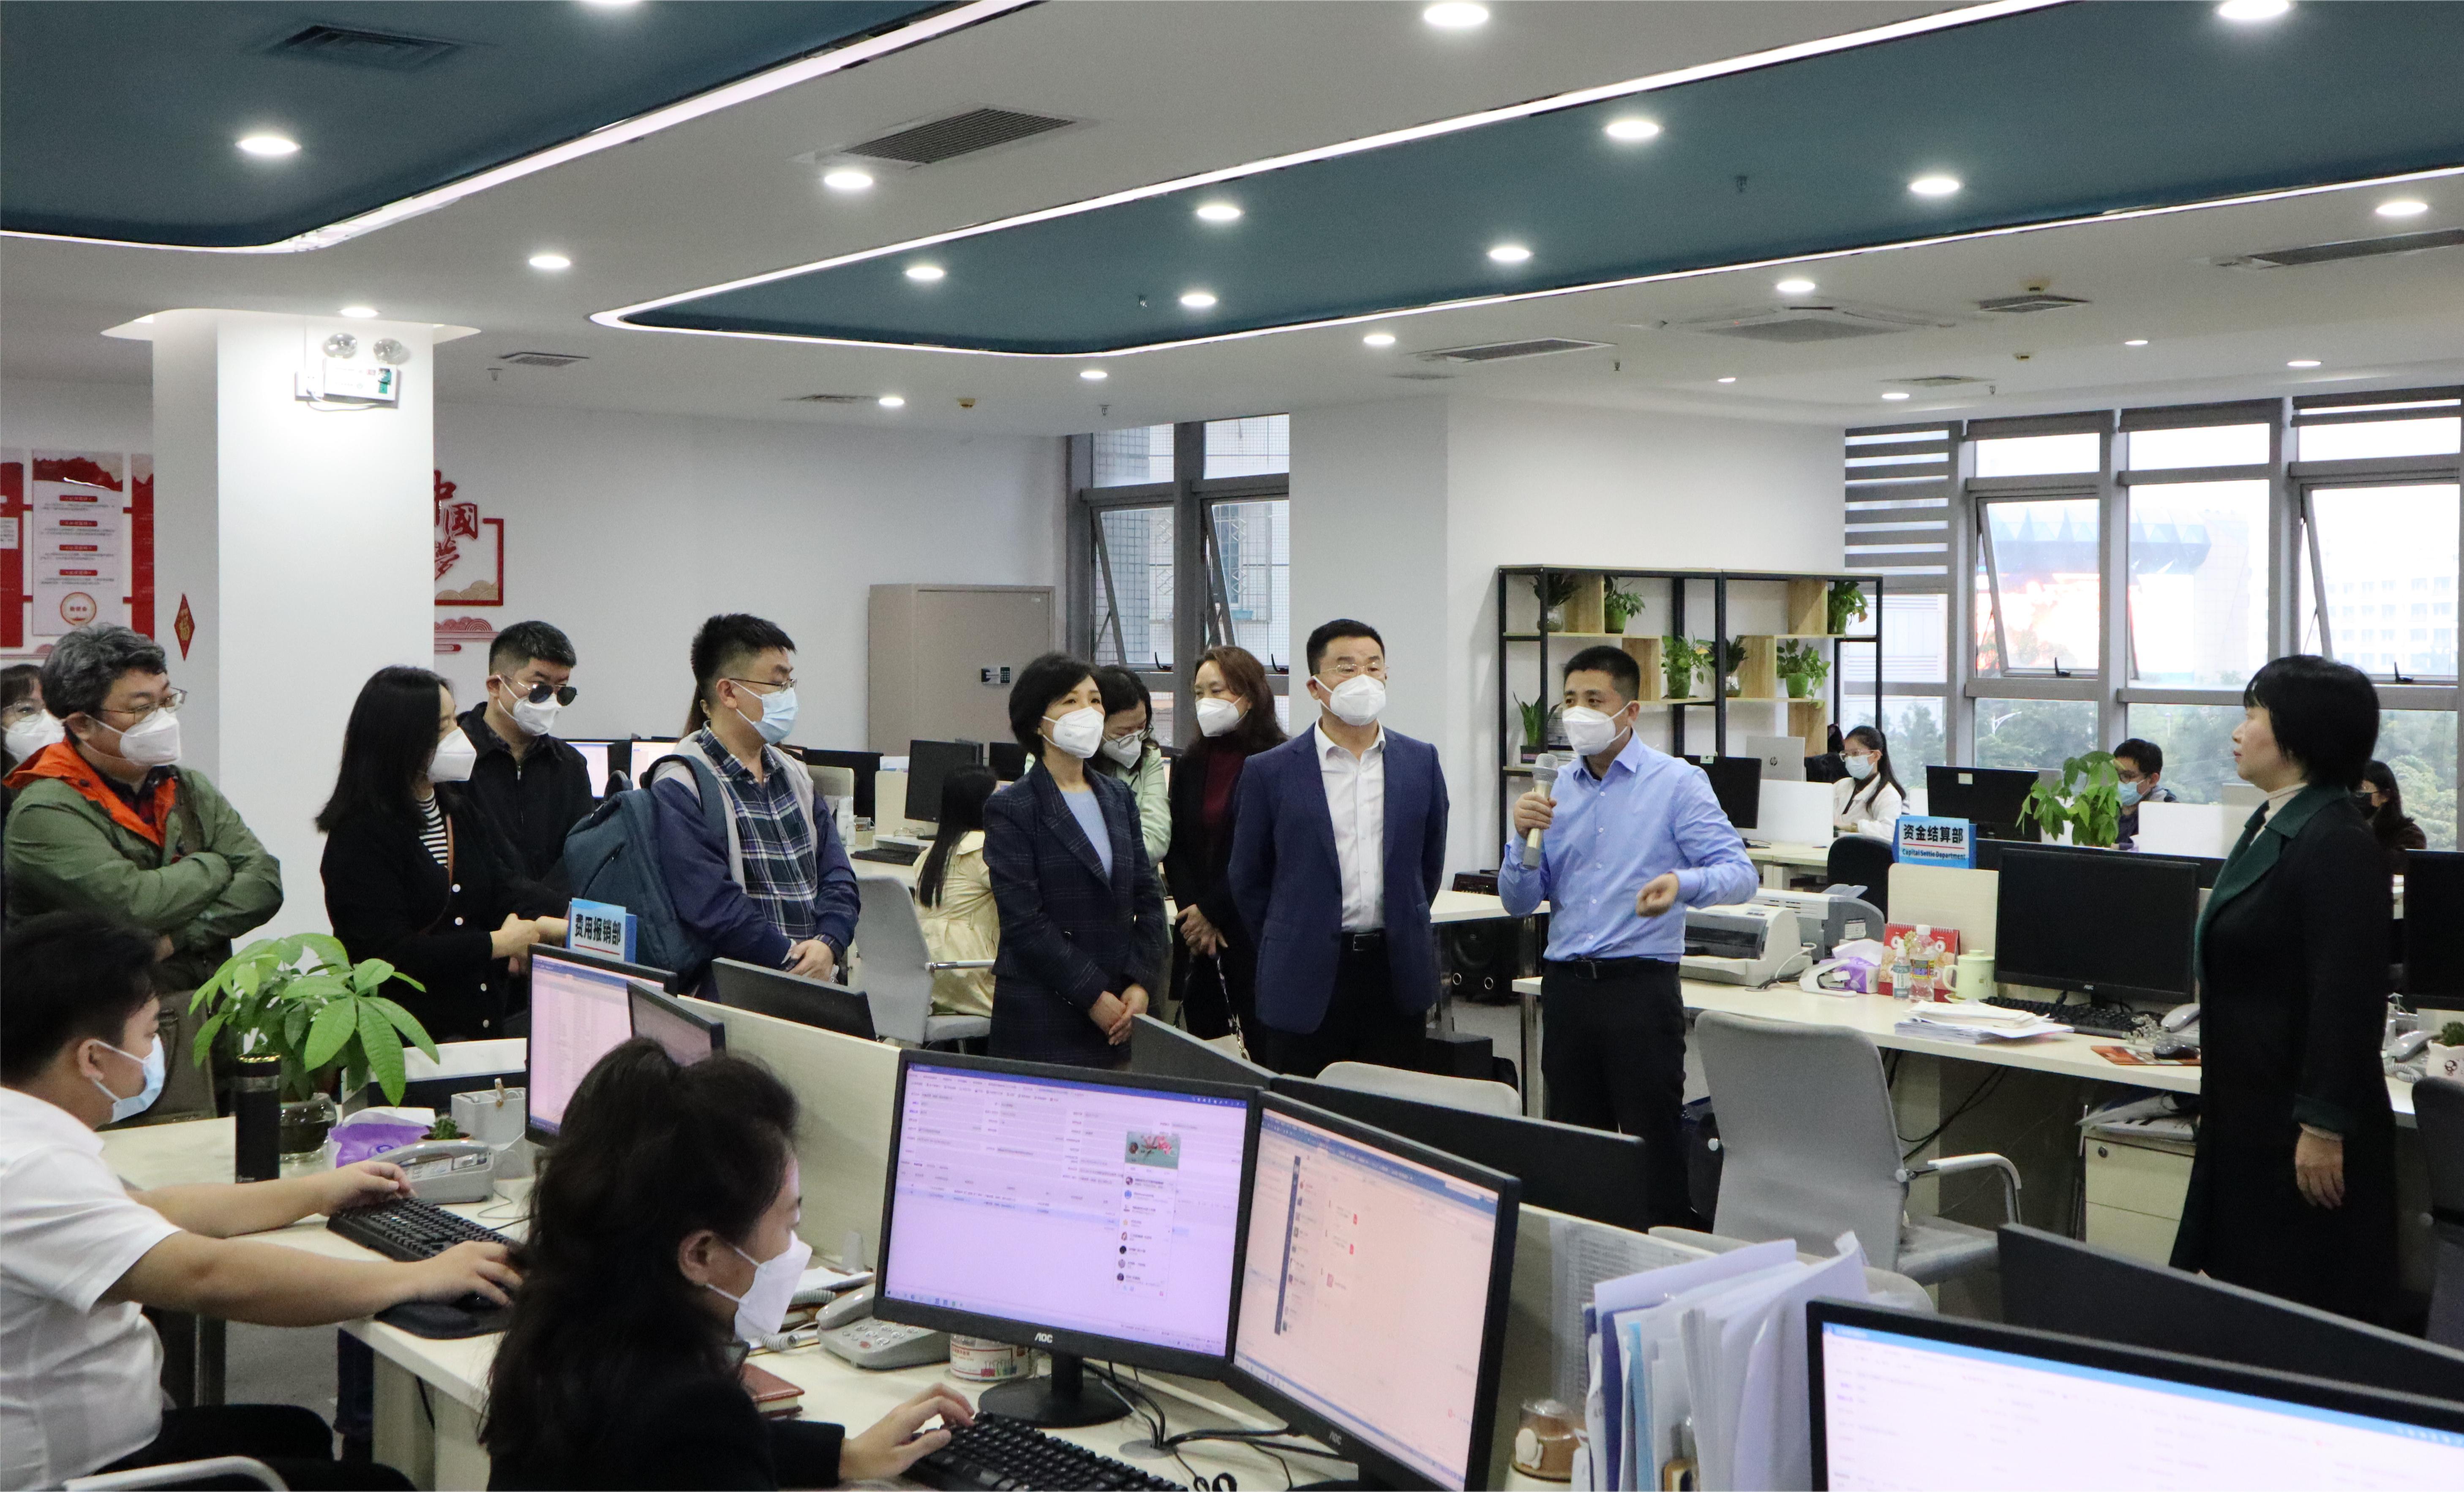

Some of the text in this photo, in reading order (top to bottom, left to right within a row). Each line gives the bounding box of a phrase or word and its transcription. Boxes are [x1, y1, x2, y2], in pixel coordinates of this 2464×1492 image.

[1903, 824, 1963, 844] 资金结算部
[1902, 849, 1920, 858] Capital
[1936, 851, 1966, 861] Department
[575, 914, 621, 946] 费用报销部
[1034, 1332, 1053, 1344] AOC
[1329, 1430, 1341, 1445] AOC
